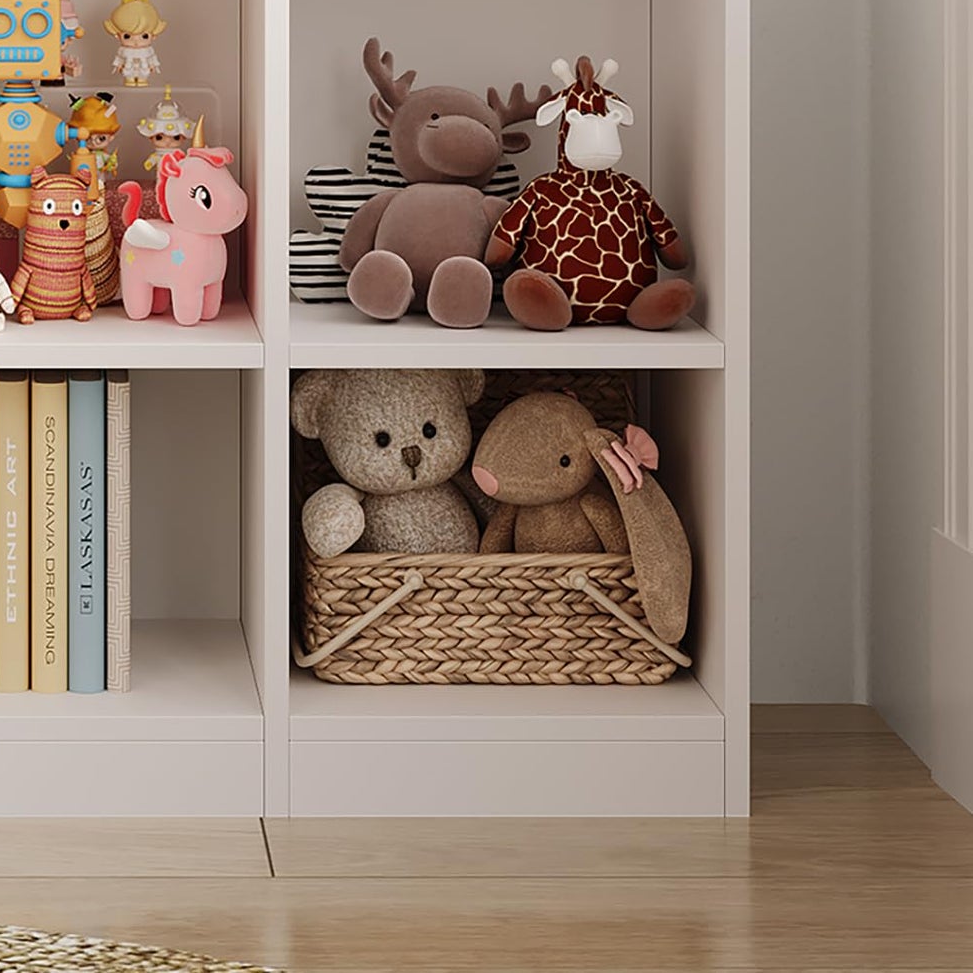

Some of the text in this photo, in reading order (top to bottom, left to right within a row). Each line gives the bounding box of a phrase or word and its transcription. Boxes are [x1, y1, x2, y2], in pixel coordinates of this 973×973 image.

[5, 438, 18, 622] ETHNIC ART
[44, 416, 55, 664] SCANDINAVIA DREAMING
[81, 467, 92, 590] LASKASAS
